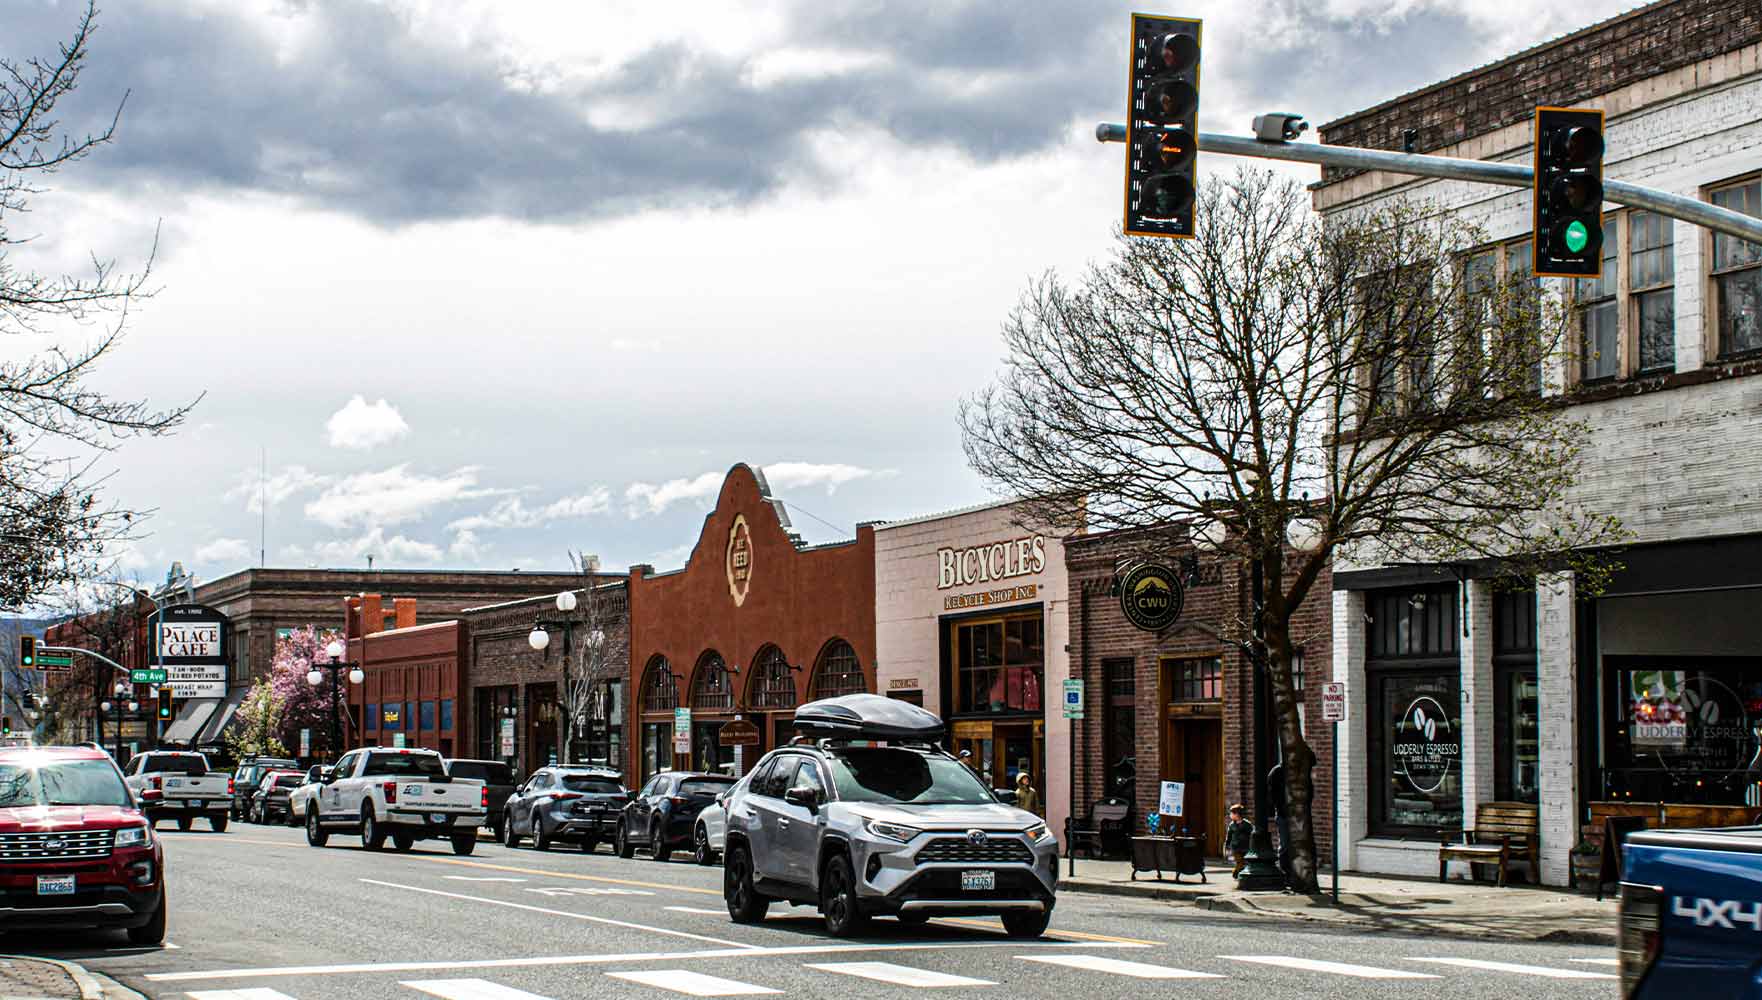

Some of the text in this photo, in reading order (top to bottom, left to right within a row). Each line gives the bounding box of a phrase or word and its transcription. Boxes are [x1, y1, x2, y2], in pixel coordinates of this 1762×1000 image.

[938, 535, 1046, 589] BICYCLES
[945, 593, 985, 609] RECYCLE
[988, 590, 1012, 603] SHOP
[1139, 598, 1167, 608] CWU
[162, 627, 217, 645] PALACE
[169, 643, 208, 656] CAFE
[133, 672, 164, 681] 4th Ave
[1328, 685, 1338, 693] NO
[1640, 726, 1697, 738] UDDERLY
[1393, 743, 1459, 755] UDDERLY ESPRESSO
